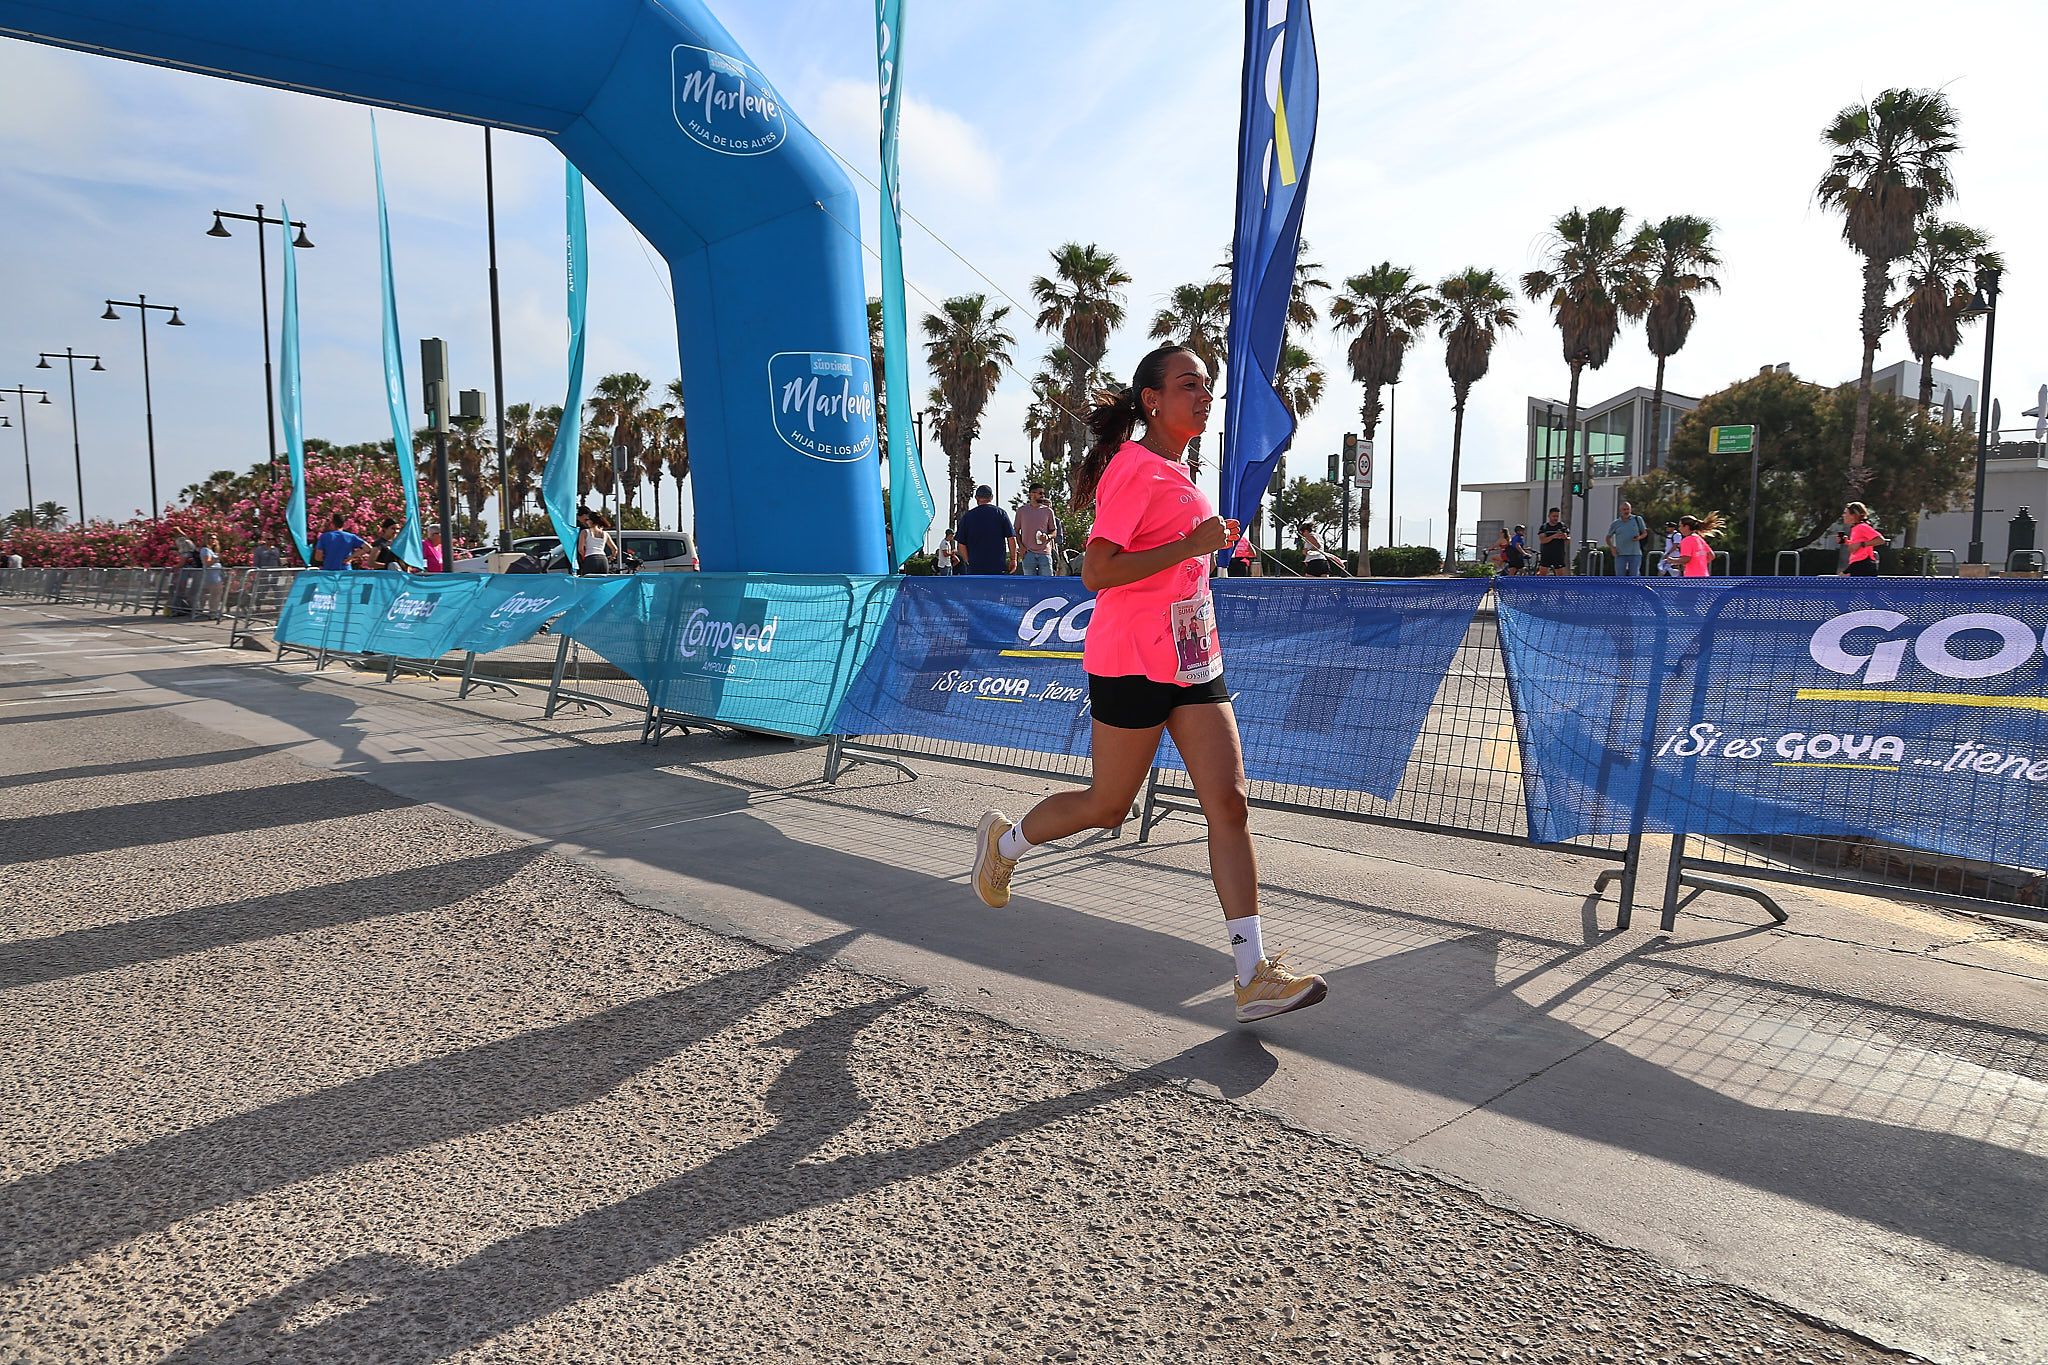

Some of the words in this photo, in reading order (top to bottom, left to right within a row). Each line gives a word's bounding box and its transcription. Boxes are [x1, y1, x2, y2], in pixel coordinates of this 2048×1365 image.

[682, 70, 778, 124] Marlene
[688, 119, 710, 140] HIJA
[713, 135, 727, 146] DE
[729, 139, 749, 149] LOS
[751, 132, 777, 148] ALPES
[782, 377, 872, 432] Marlene
[791, 430, 814, 450] HIJA
[817, 443, 831, 454] DE
[834, 446, 851, 455] LOS
[853, 434, 871, 453] ALPES
[680, 607, 778, 658] Compeed
[1018, 596, 1097, 647] GO
[1809, 609, 2048, 685] GO
[702, 662, 736, 675] AMPOLLAS
[1186, 670, 1210, 680] OYSHO
[957, 679, 979, 694] es
[978, 677, 1030, 697] GOYA
[1723, 737, 1768, 759] es
[1775, 733, 1905, 762] GOYA
